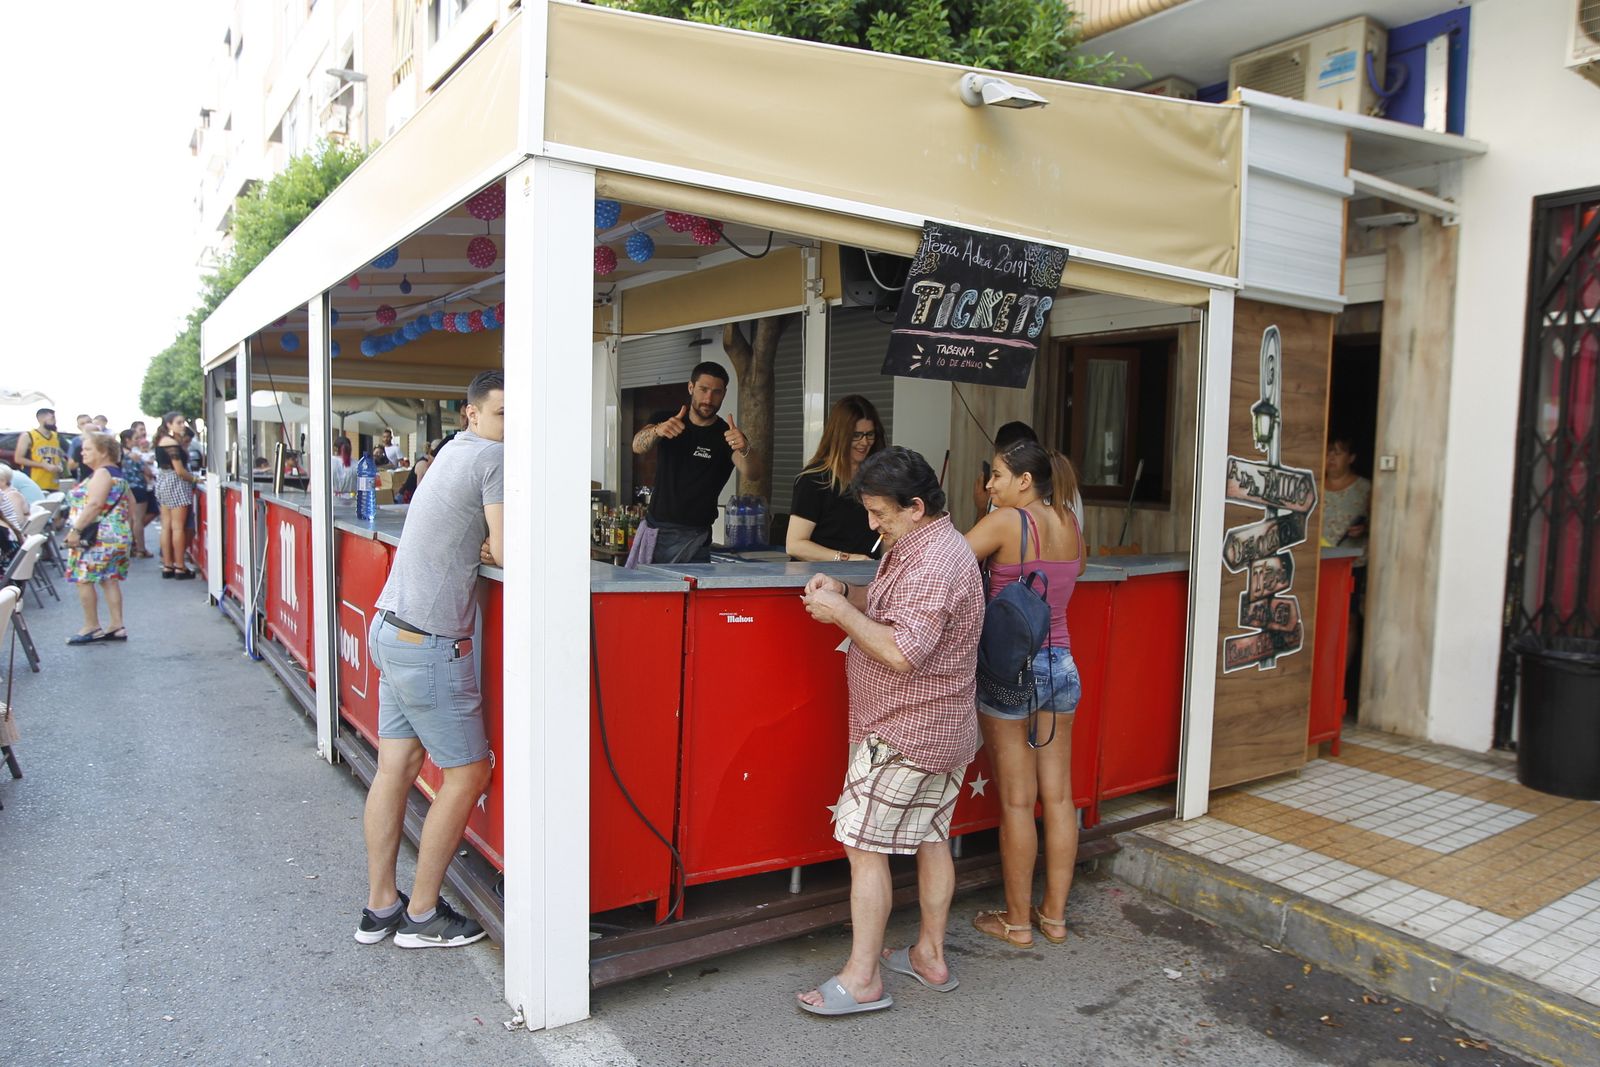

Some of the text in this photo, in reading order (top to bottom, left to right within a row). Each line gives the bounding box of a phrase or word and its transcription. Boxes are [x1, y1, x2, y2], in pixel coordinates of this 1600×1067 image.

[962, 235, 993, 269] Adra
[994, 243, 1028, 283] 2019!
[935, 344, 976, 358] TABERNA
[925, 355, 932, 367] A
[949, 358, 959, 368] DE
[960, 359, 984, 370] EMILIO
[727, 614, 754, 624] Mahou
